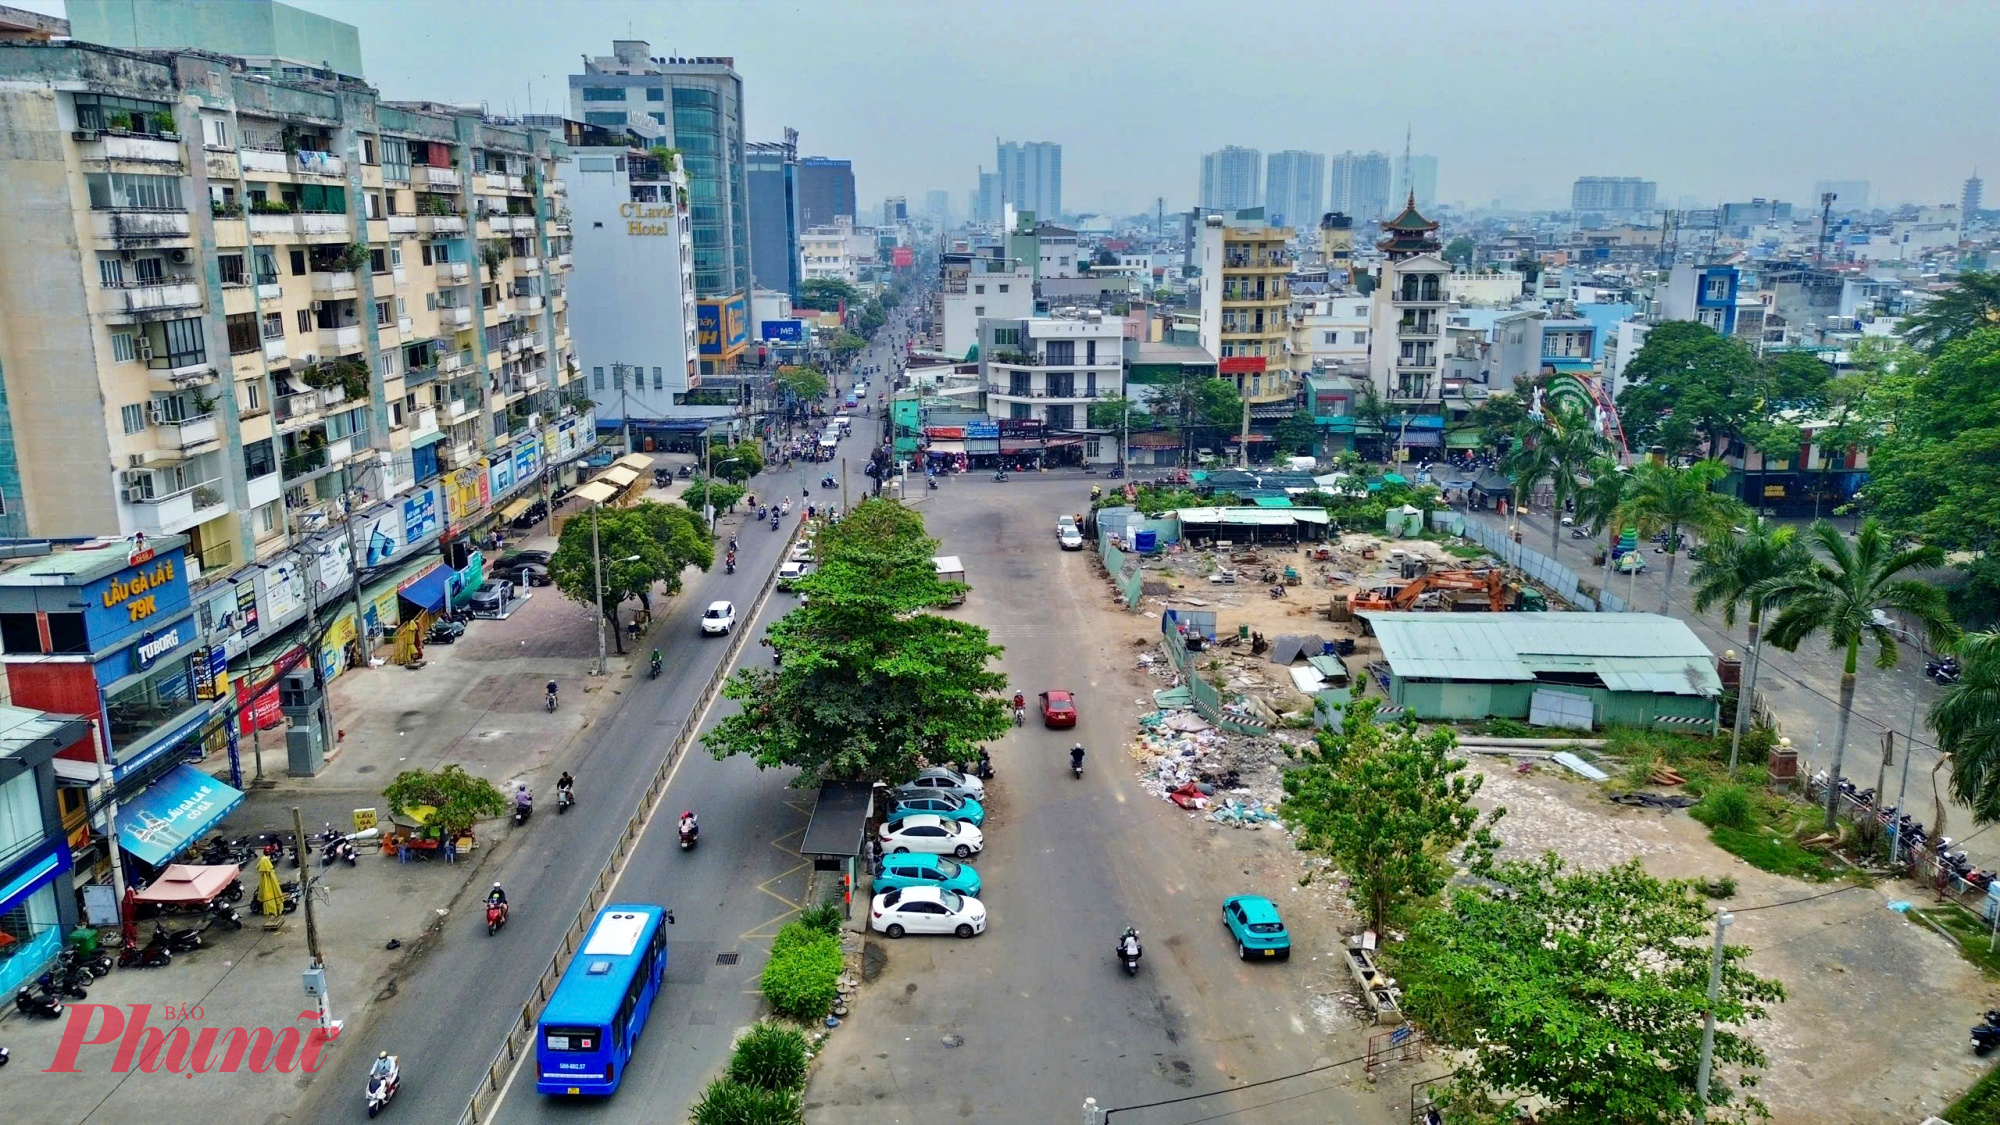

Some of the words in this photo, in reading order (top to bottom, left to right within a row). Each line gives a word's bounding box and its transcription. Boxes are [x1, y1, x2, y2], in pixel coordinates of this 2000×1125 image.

[628, 221, 668, 236] Hotel
[103, 577, 129, 607] LẨU
[131, 570, 149, 594] GÀ
[149, 562, 165, 588] LÁ
[165, 559, 174, 580] É
[127, 595, 157, 622] 79K
[138, 629, 179, 664] TUBORG
